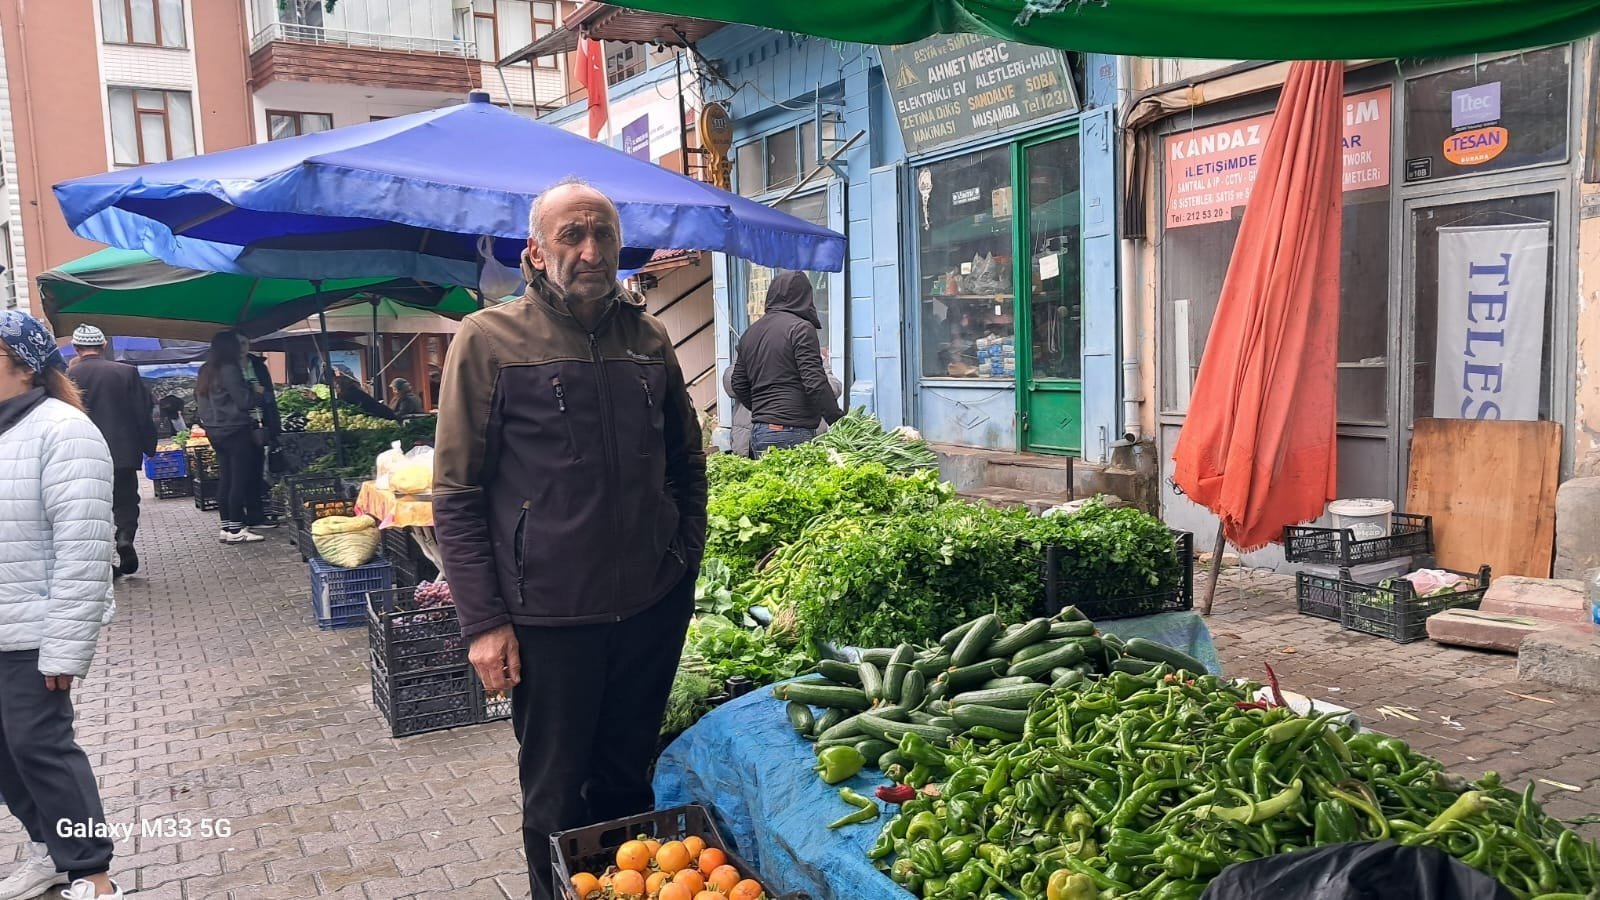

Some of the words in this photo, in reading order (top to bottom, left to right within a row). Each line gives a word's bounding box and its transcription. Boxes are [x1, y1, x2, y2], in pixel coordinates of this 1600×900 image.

[928, 56, 967, 84] AHMET
[953, 80, 966, 97] EV
[968, 84, 1016, 111] SANDALYE
[1025, 71, 1058, 93] SOBA
[1171, 124, 1261, 161] KANDAZ
[1342, 135, 1361, 148] AR
[1343, 150, 1372, 166] TWORK
[1186, 211, 1200, 220] 212
[1202, 209, 1212, 218] 53
[1214, 208, 1223, 217] 20
[1461, 253, 1512, 419] TELES
